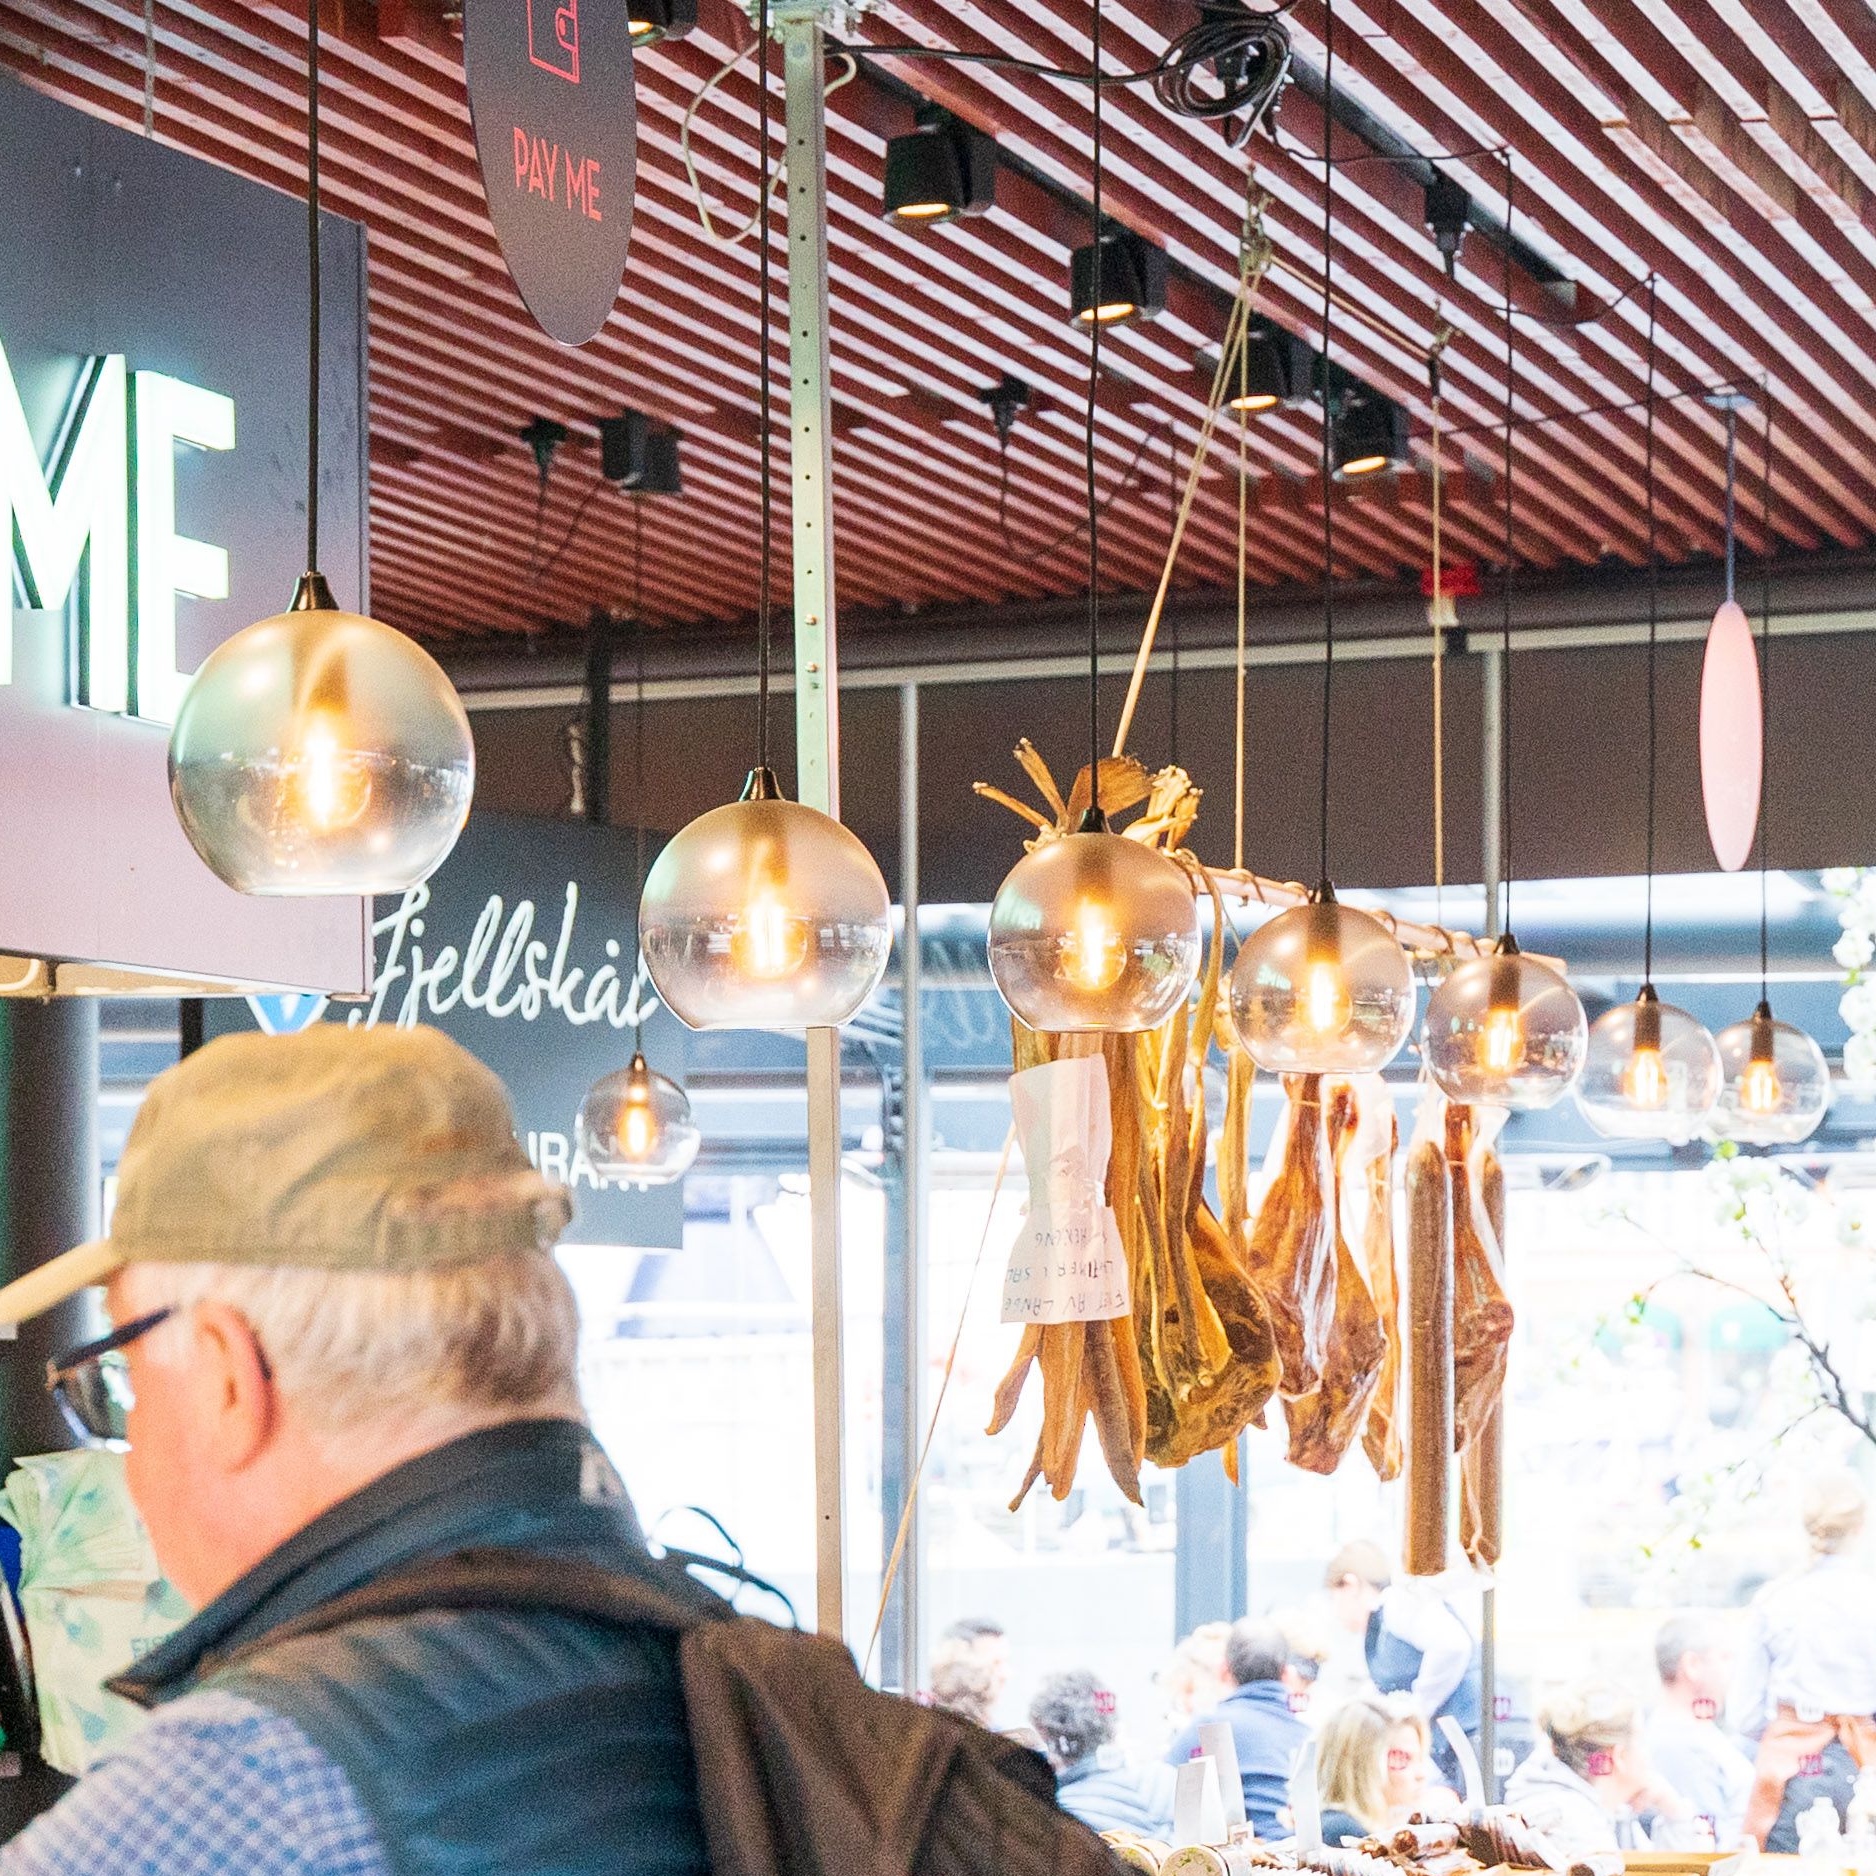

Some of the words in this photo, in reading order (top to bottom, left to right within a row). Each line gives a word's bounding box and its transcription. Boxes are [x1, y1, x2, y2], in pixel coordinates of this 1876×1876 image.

[513, 127, 559, 203] PAY
[564, 149, 604, 222] ME
[348, 880, 661, 1031] Fjellskål
